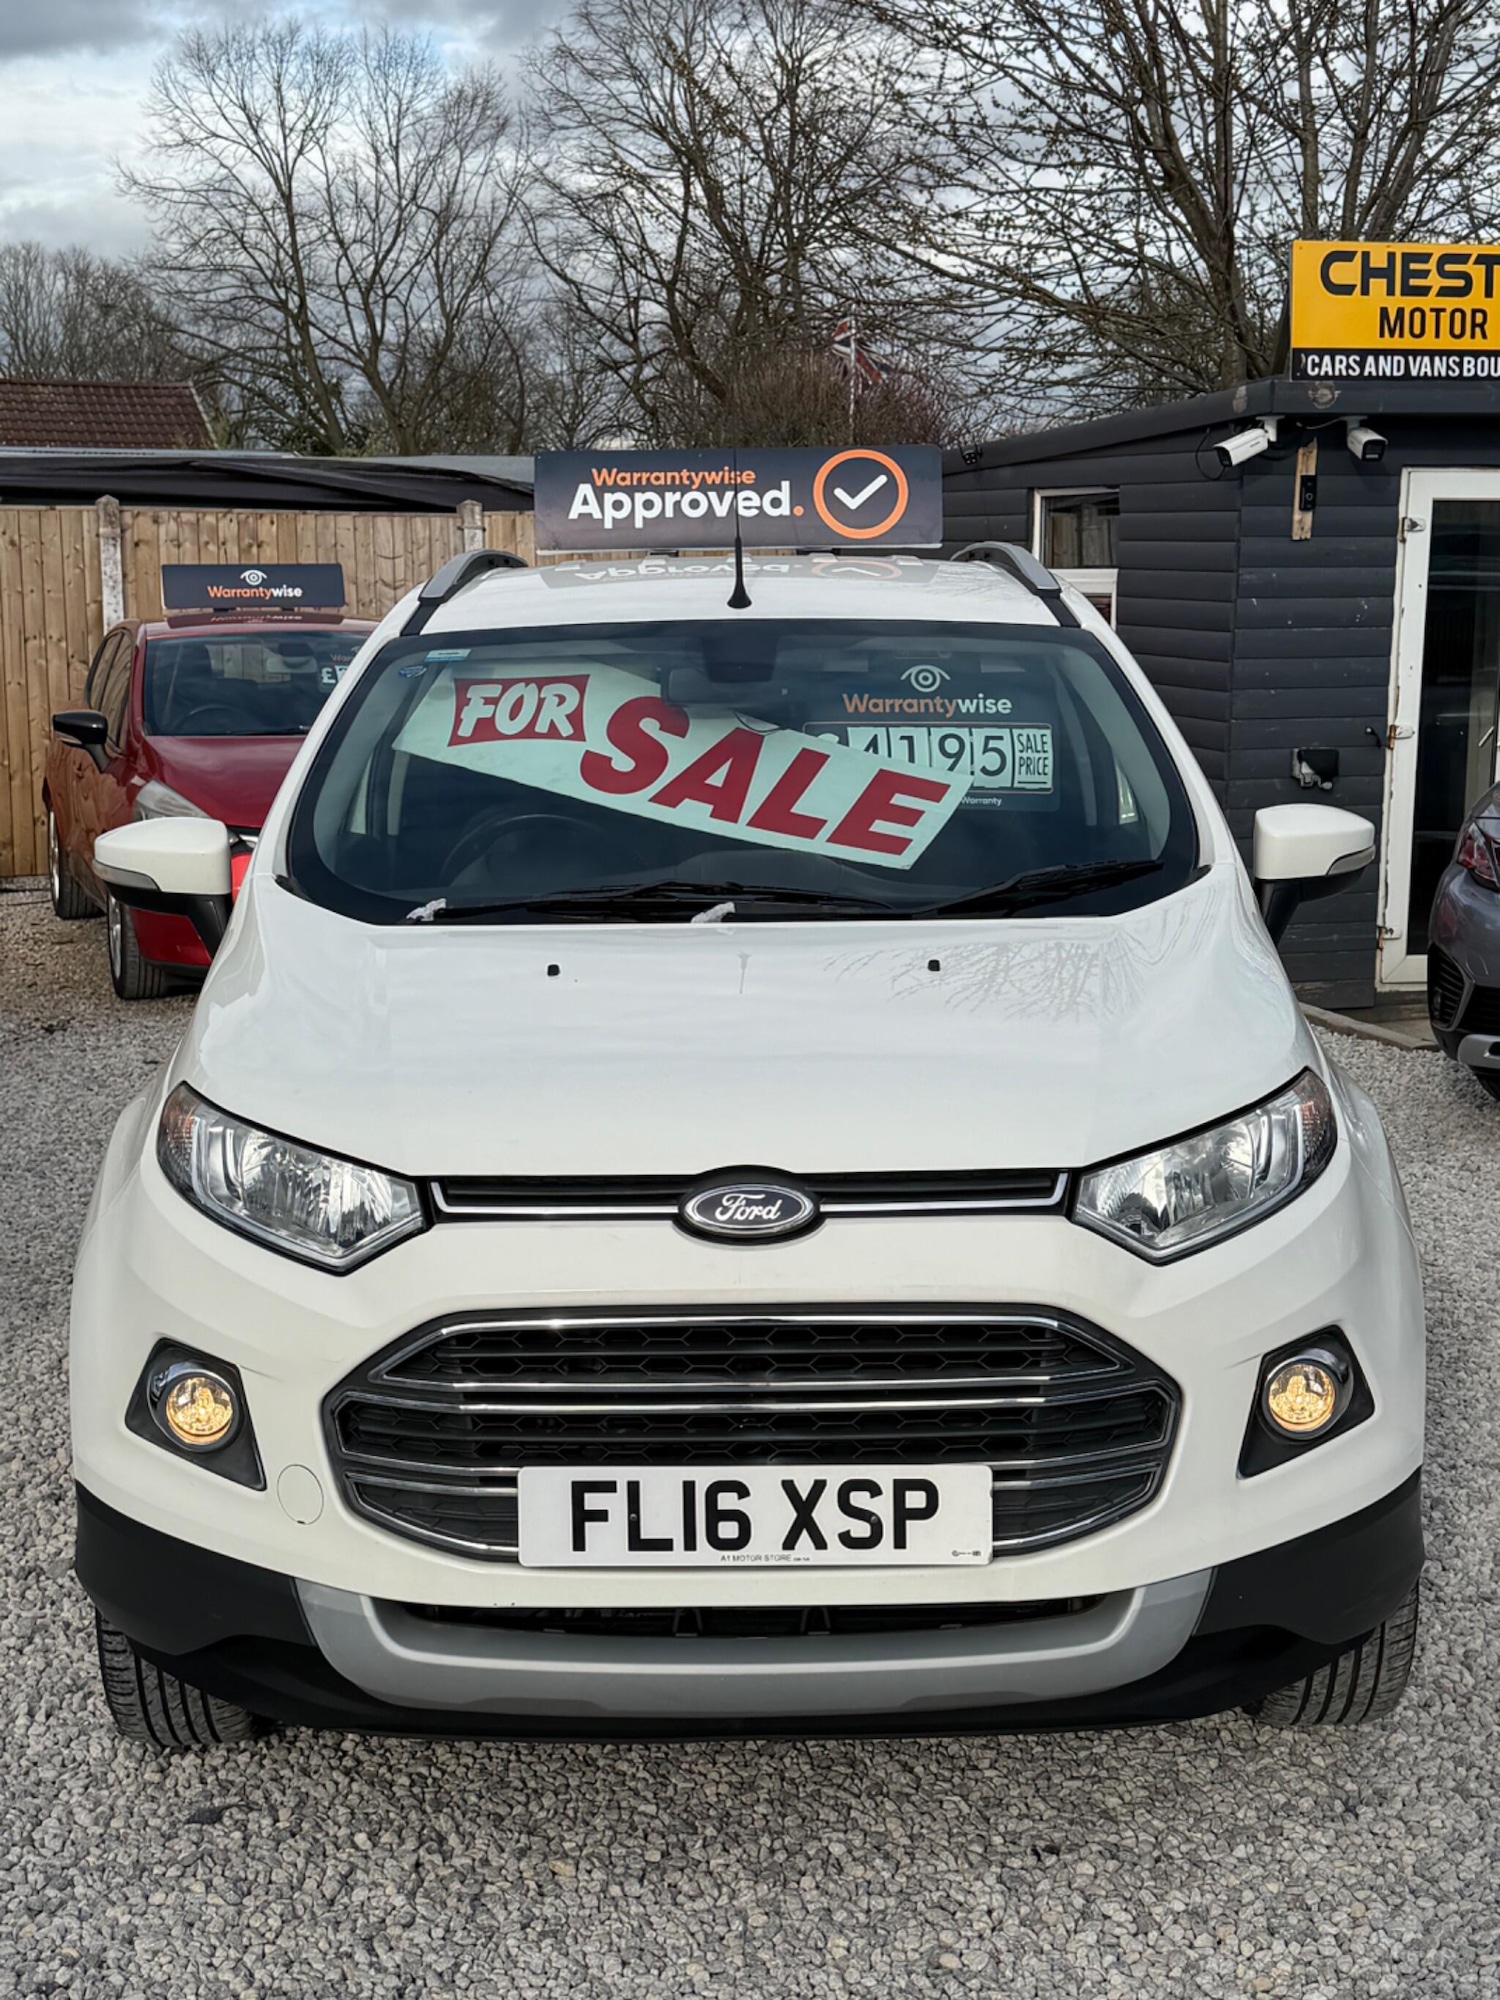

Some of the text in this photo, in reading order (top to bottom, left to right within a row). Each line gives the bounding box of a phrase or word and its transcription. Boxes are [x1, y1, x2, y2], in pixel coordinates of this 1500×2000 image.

[1320, 250, 1500, 299] CHEST
[1378, 306, 1488, 340] MOTOR
[1306, 353, 1500, 377] CARS AND VANS BOU
[591, 466, 756, 490] Warrantywise
[568, 480, 804, 529] Approved.
[207, 584, 303, 600] Warrantywise
[842, 693, 1013, 718] Warrantywise
[1016, 732, 1048, 754] SALE
[456, 682, 952, 856] FOR SALE
[1018, 755, 1049, 776] PRICE
[715, 1193, 782, 1221] Ford
[570, 1478, 939, 1552] FL16 XSP
[732, 1554, 762, 1562] MOTOR
[764, 1553, 792, 1561] STORE
